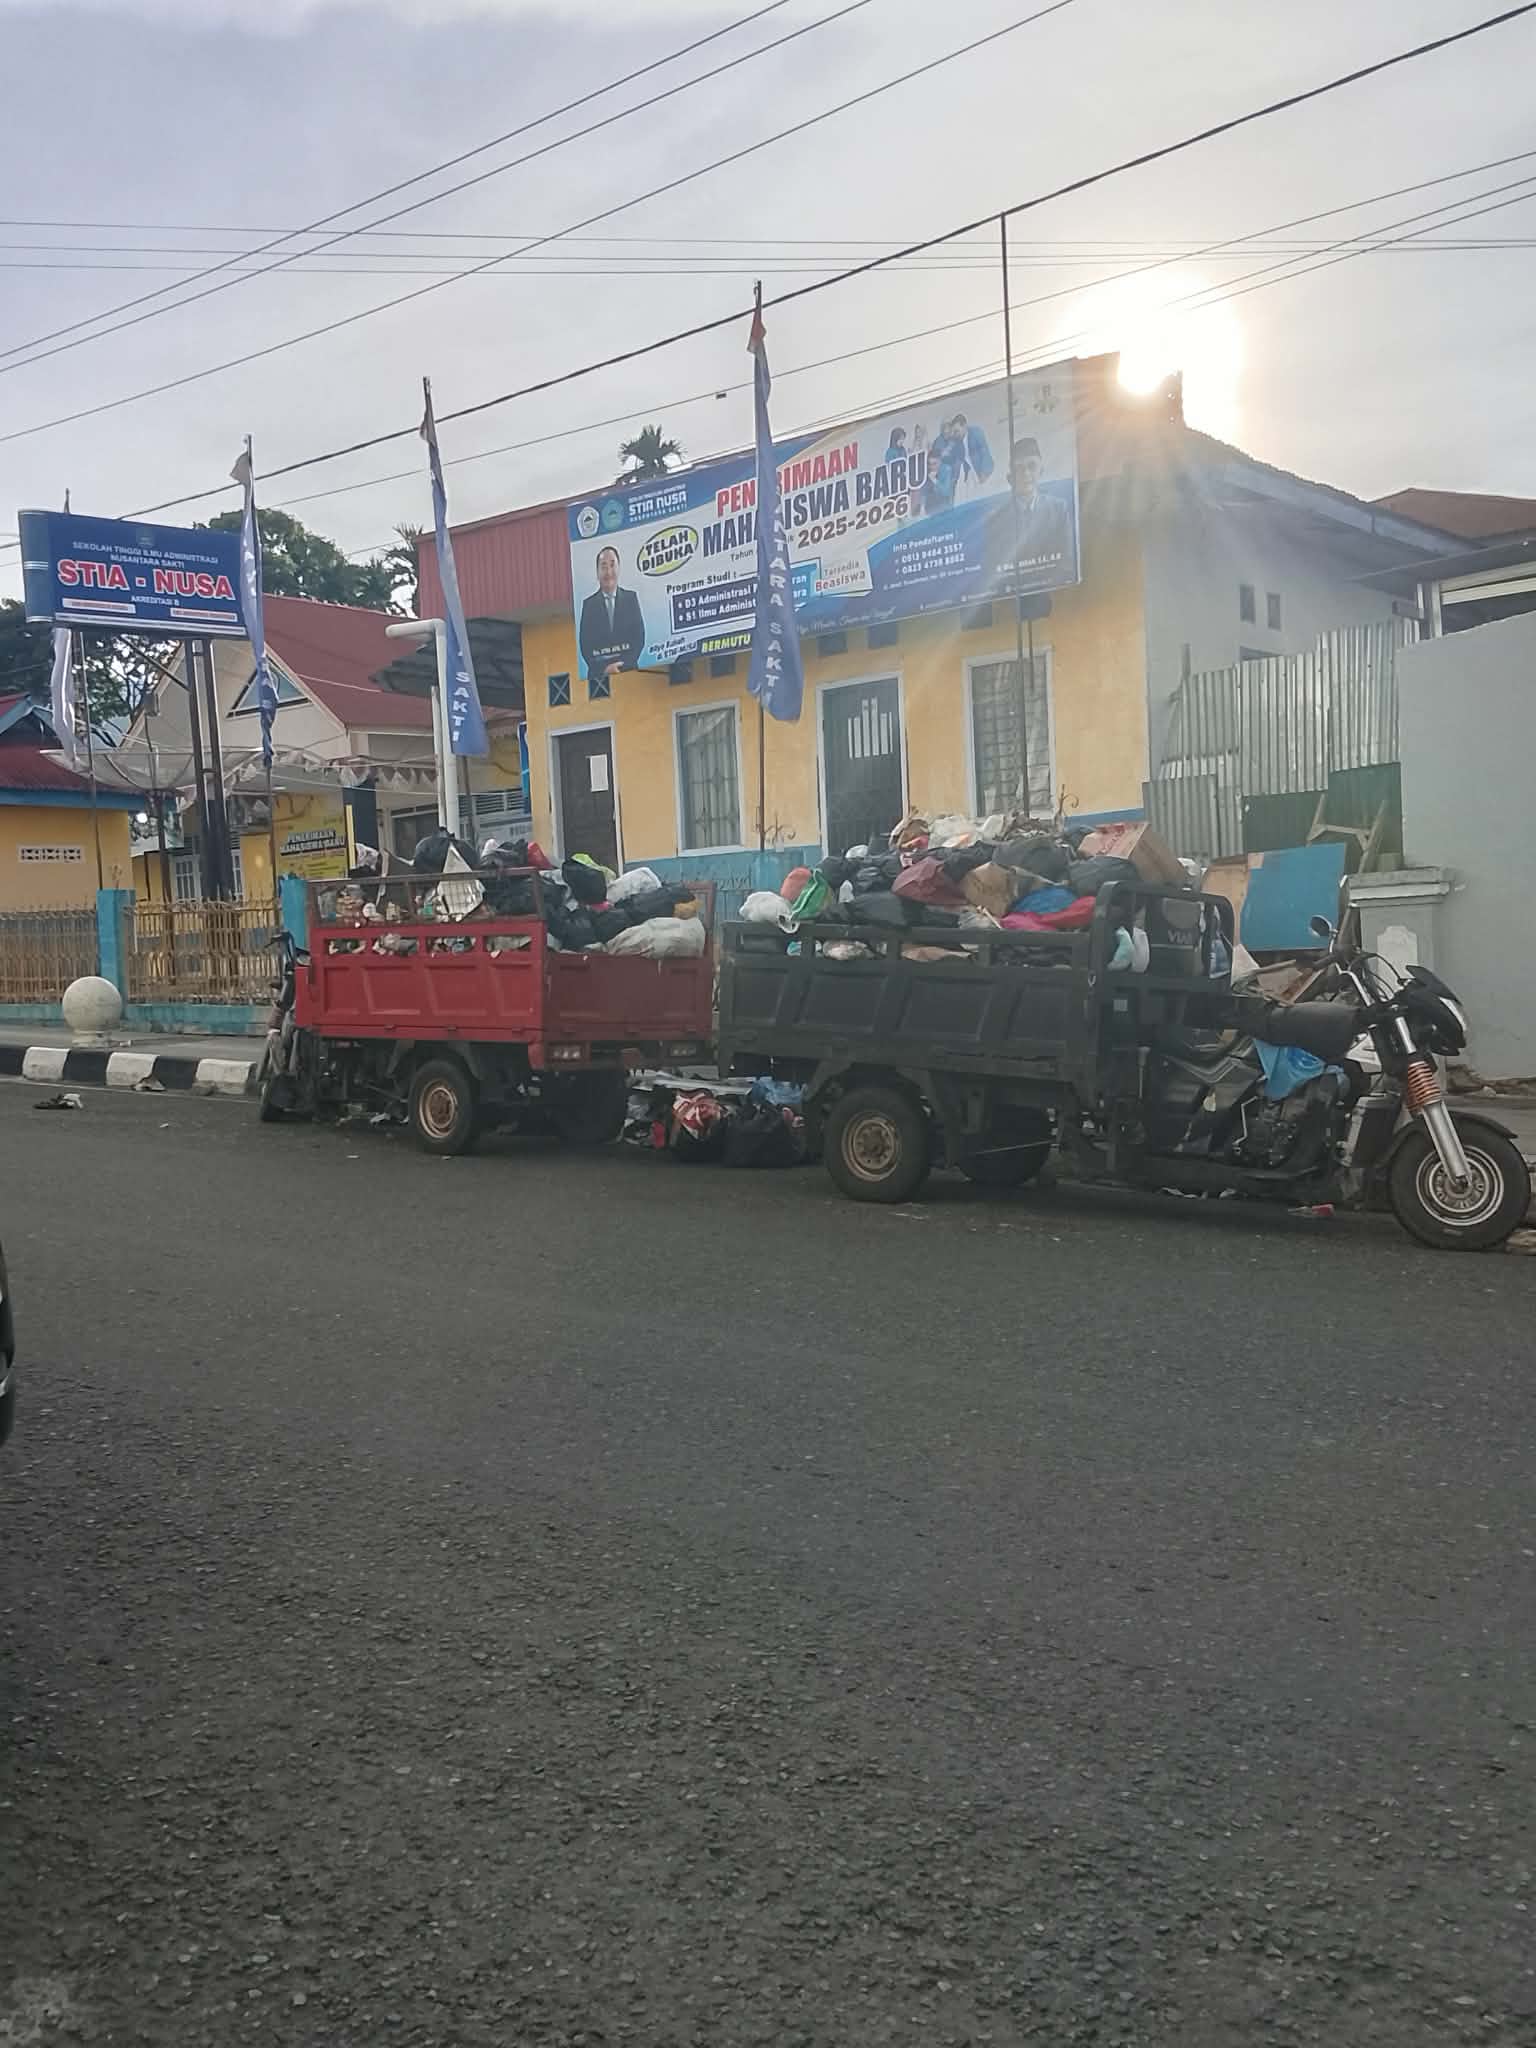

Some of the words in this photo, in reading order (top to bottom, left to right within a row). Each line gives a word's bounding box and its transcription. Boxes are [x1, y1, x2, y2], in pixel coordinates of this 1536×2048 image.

[717, 441, 859, 519] PENIMAAN
[629, 499, 654, 516] STIA
[656, 490, 687, 509] NUSA
[703, 480, 849, 558] MAHISWA
[855, 451, 926, 507] BARU
[798, 496, 908, 548] 2025-2026
[73, 541, 113, 552] SEKOLAH
[646, 530, 689, 556] TELAH
[642, 543, 694, 571] DIBUKA
[57, 558, 130, 590] STIA
[153, 568, 236, 600] NUSA
[666, 579, 705, 594] Program
[707, 571, 731, 584] Studi
[816, 570, 866, 592] Beasiswa
[698, 584, 751, 605] Administrasi
[719, 598, 756, 614] Administ
[701, 633, 751, 653] BERMUTU
[452, 672, 470, 741] SAKTI
